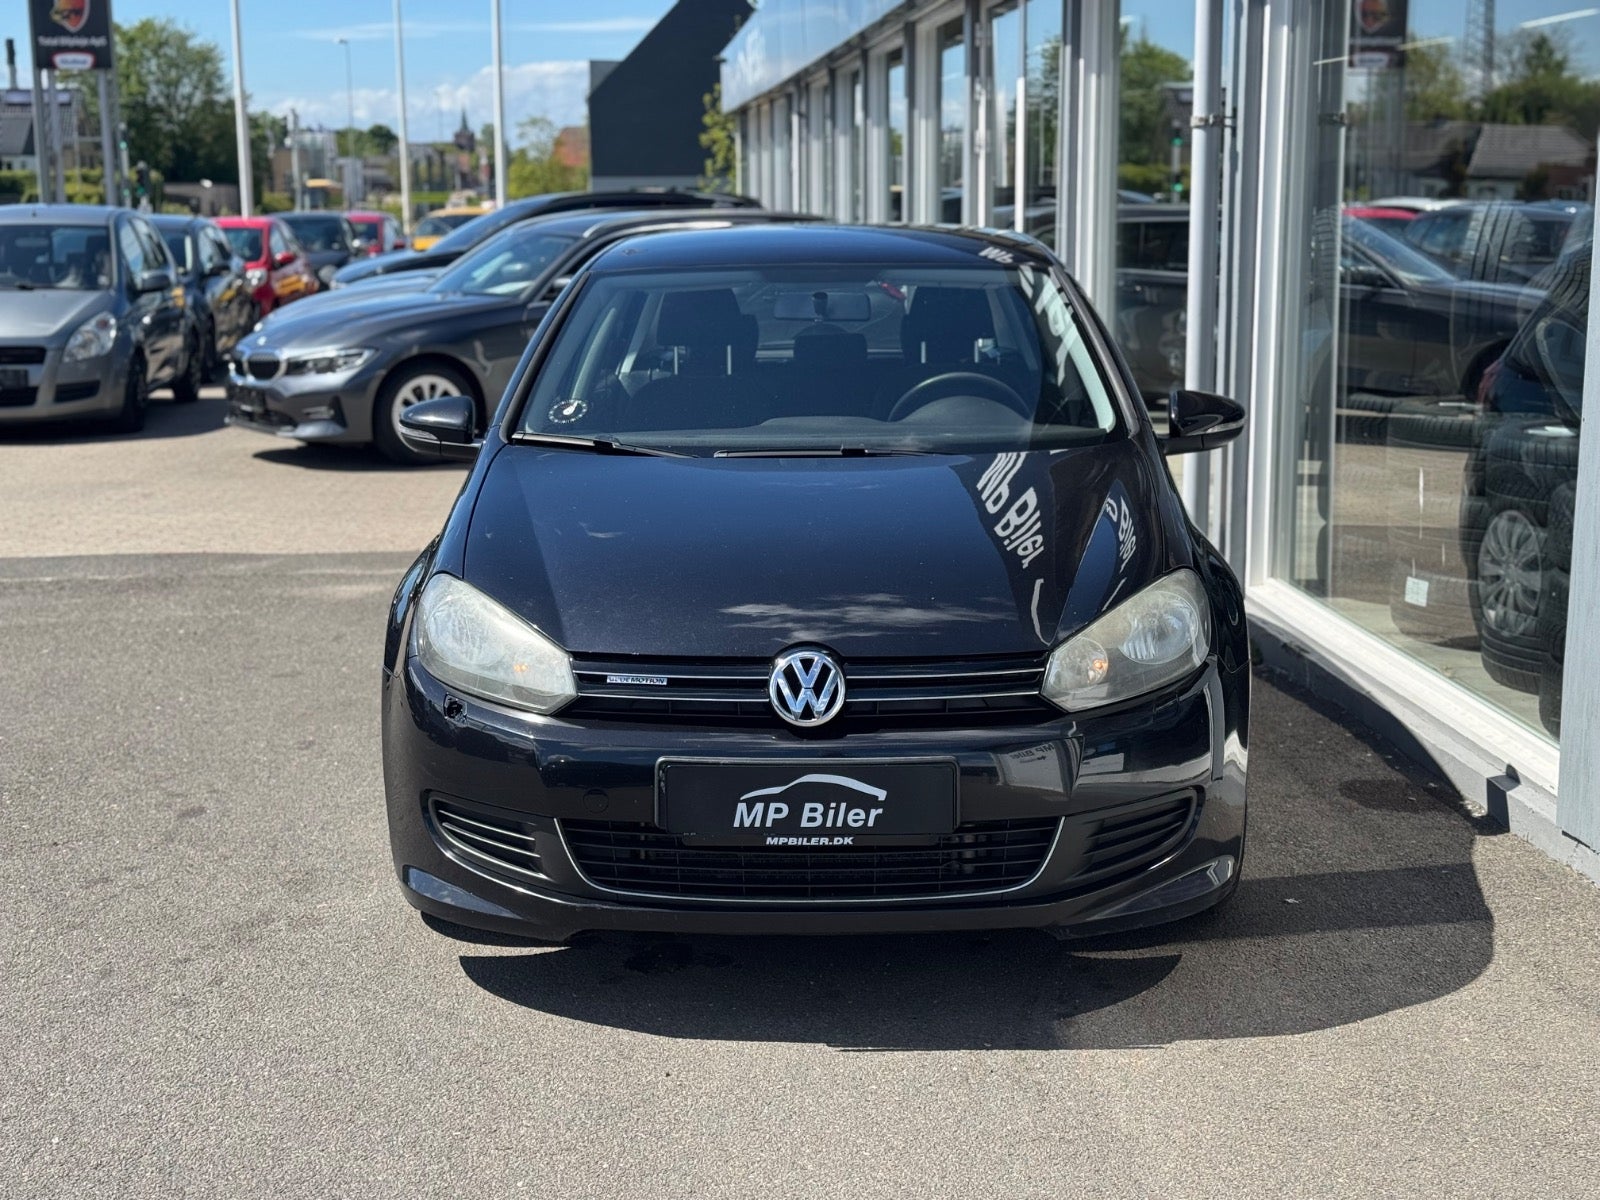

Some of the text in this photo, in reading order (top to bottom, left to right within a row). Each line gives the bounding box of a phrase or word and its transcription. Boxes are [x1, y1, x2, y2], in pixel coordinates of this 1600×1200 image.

[733, 802, 883, 828] MP Biler
[766, 836, 854, 846] MPBILER.DK
